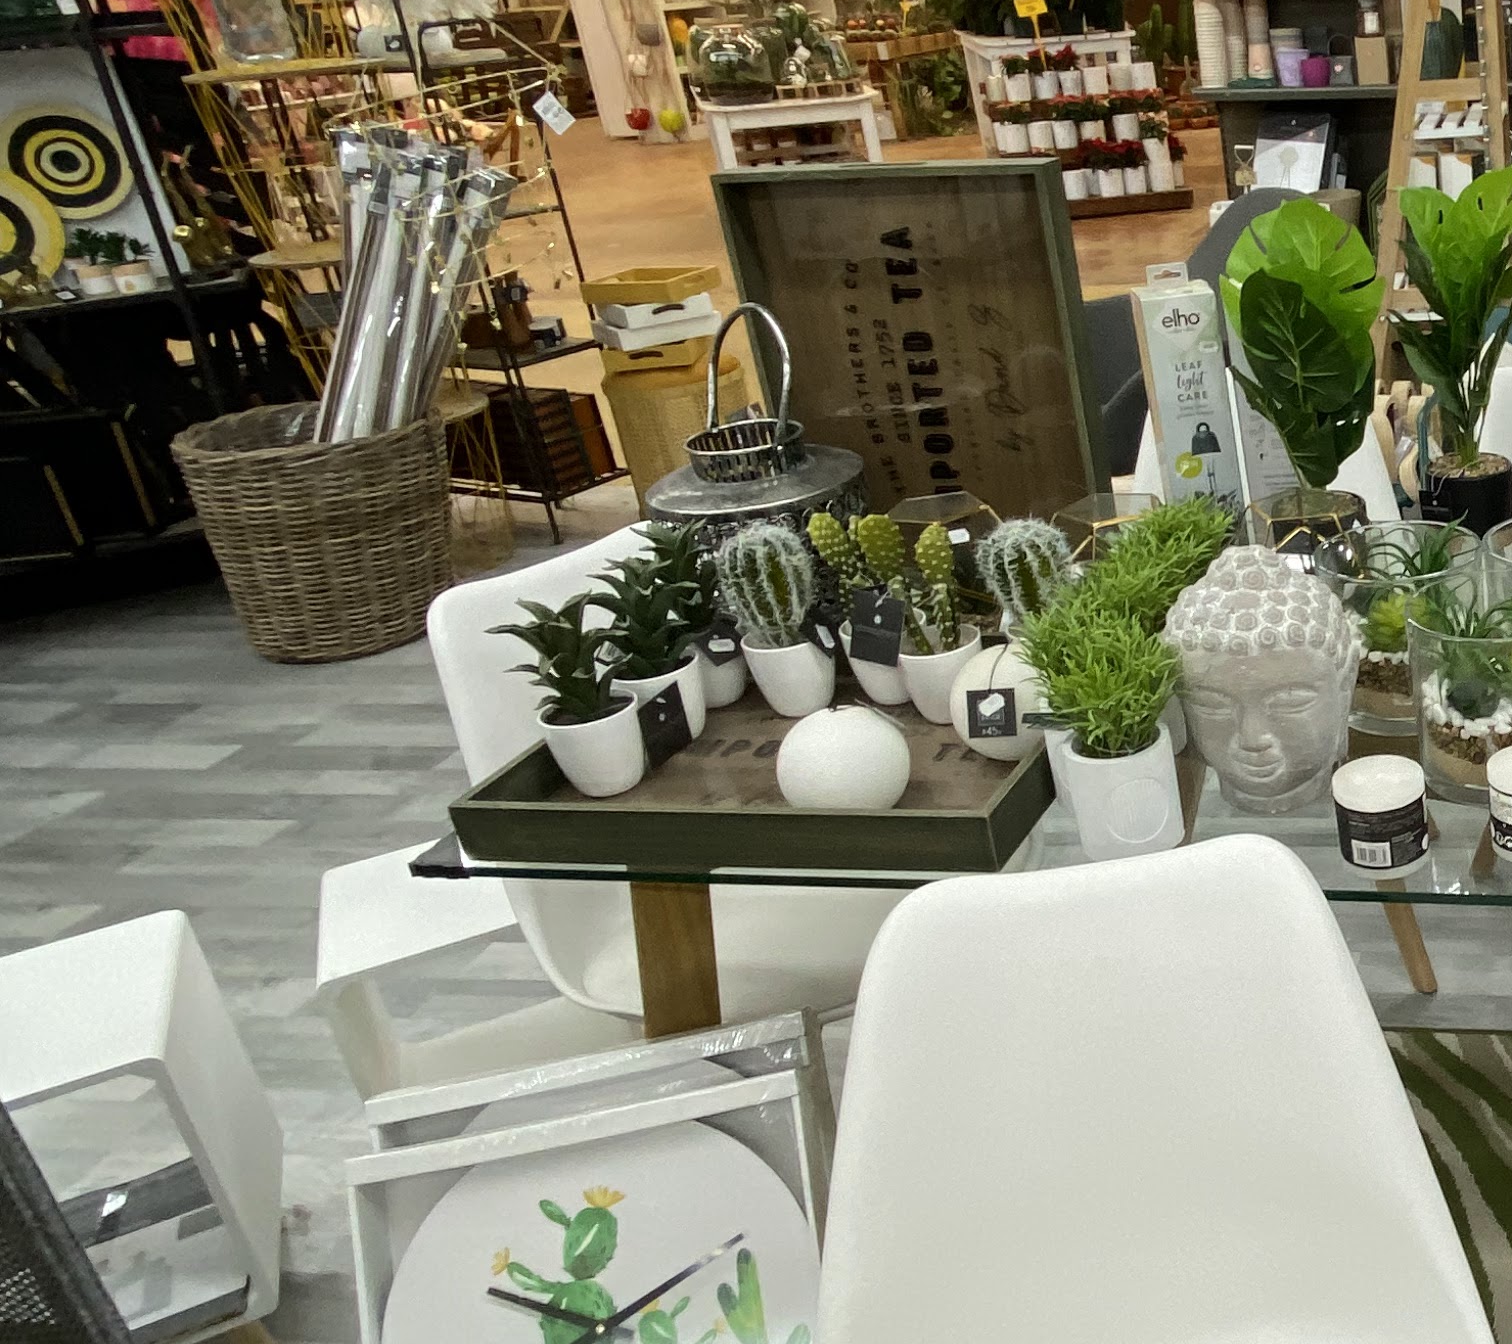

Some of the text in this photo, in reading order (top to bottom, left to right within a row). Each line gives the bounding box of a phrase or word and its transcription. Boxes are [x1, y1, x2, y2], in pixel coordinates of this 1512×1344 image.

[880, 226, 922, 304] TEA
[1162, 308, 1200, 328] elho
[845, 327, 886, 444] BROTHERS
[872, 319, 912, 443] SINCE 1752
[1175, 359, 1203, 372] LEAF
[1176, 371, 1206, 391] light
[902, 330, 964, 494] PORTED
[1177, 390, 1209, 402] CARE
